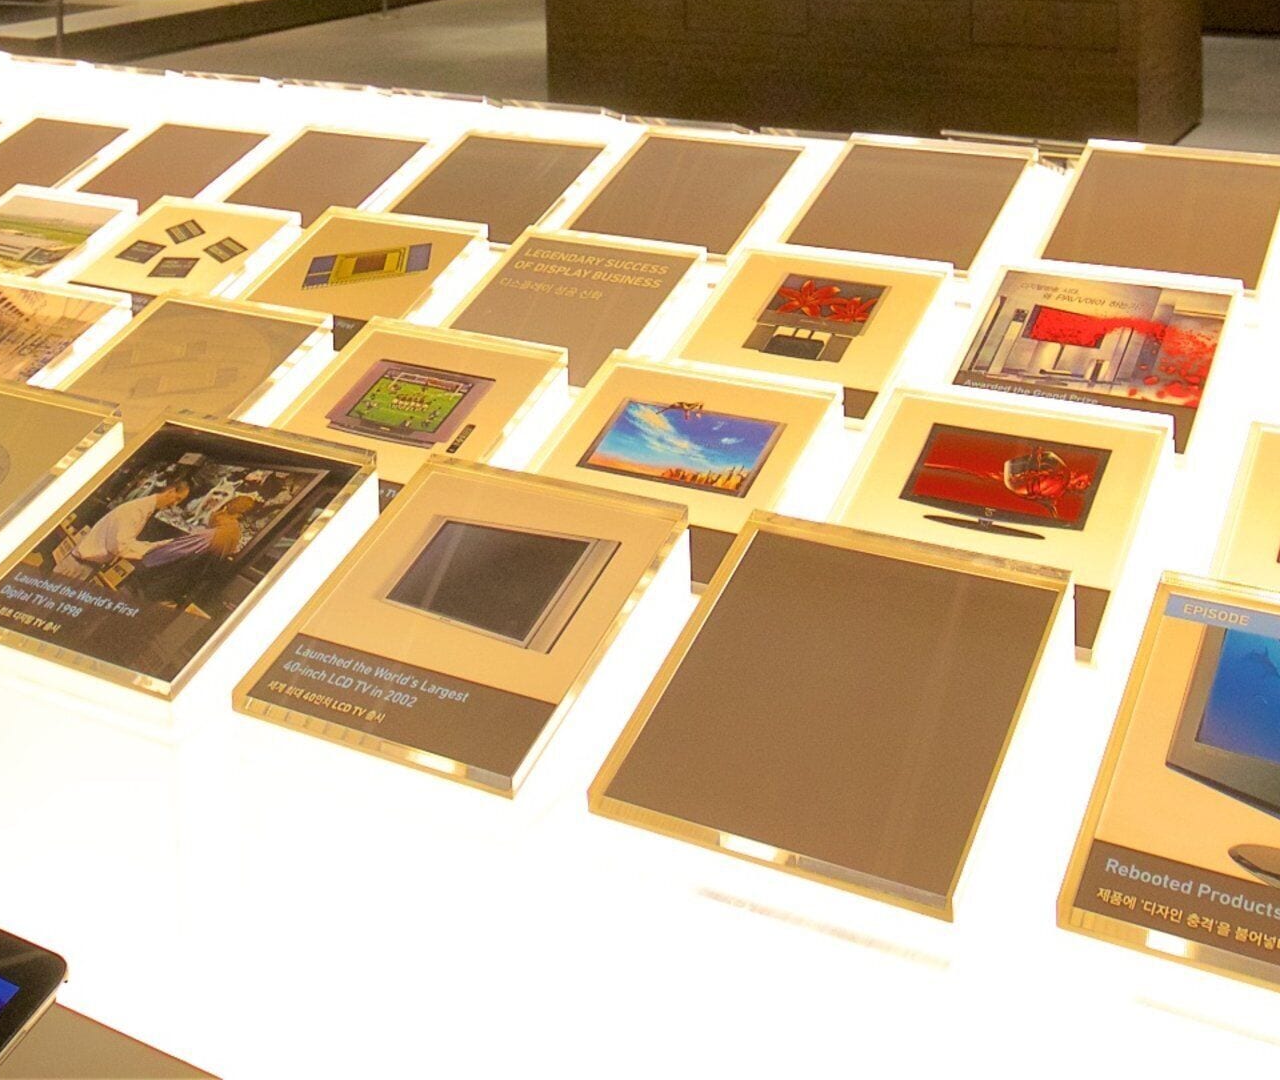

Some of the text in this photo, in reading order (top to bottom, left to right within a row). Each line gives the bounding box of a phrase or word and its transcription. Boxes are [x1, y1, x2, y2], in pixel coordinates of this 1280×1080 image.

[514, 261, 662, 289] OF DISPLAY BUSINESS
[524, 248, 670, 276] LEGENDARY SUCCESS
[500, 276, 553, 296] 디스플레이
[579, 288, 604, 301] 신화
[963, 379, 1099, 405] Awarded the Grand Prize
[0, 584, 84, 618] Digital TV in 1998
[13, 571, 140, 618] Launched the World's First
[34, 617, 46, 629] TV
[1183, 603, 1250, 626] EPISODE
[283, 660, 418, 708] 40-inch LCD TV in 2002
[295, 644, 470, 704] Launched the World's Largest
[303, 691, 332, 708] 40인치
[331, 698, 352, 712] LCD
[351, 705, 367, 718] TV
[366, 709, 386, 724] 출시
[1104, 857, 1194, 896] Rebooted
[1096, 886, 1136, 910] 제품에
